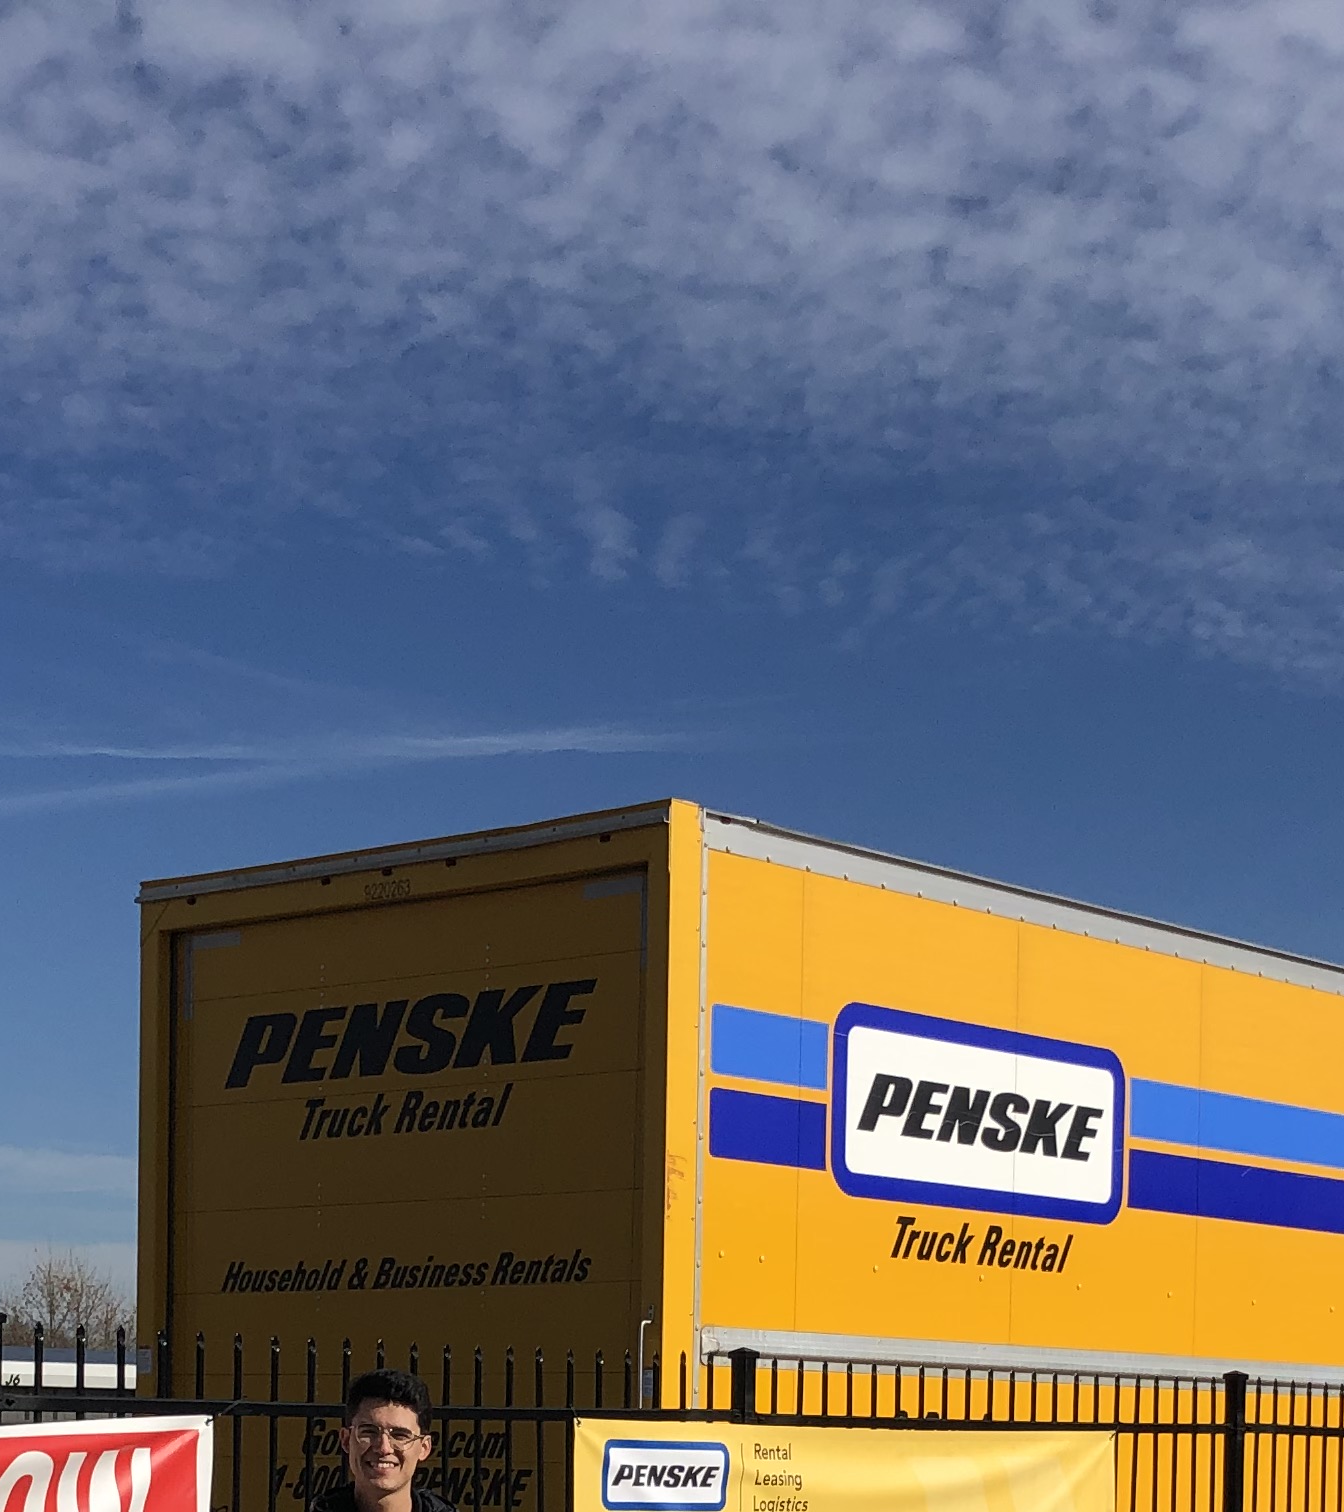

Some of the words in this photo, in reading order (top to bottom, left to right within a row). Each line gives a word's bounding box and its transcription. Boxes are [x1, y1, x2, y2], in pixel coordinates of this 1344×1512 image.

[225, 978, 598, 1090] PENSKE
[299, 1093, 388, 1142] Truck
[393, 1084, 513, 1134] Rental
[857, 1072, 1104, 1162] PENSKE
[889, 1215, 974, 1266] Truck
[977, 1223, 1073, 1274] Rental
[221, 1260, 347, 1293] Household
[348, 1257, 366, 1291] &
[372, 1255, 490, 1291] Business
[490, 1249, 593, 1286] Rentals
[4, 1374, 21, 1387] J6
[753, 1443, 791, 1461] Rental
[612, 1464, 720, 1489] PENSKE
[754, 1470, 802, 1491] Leasing
